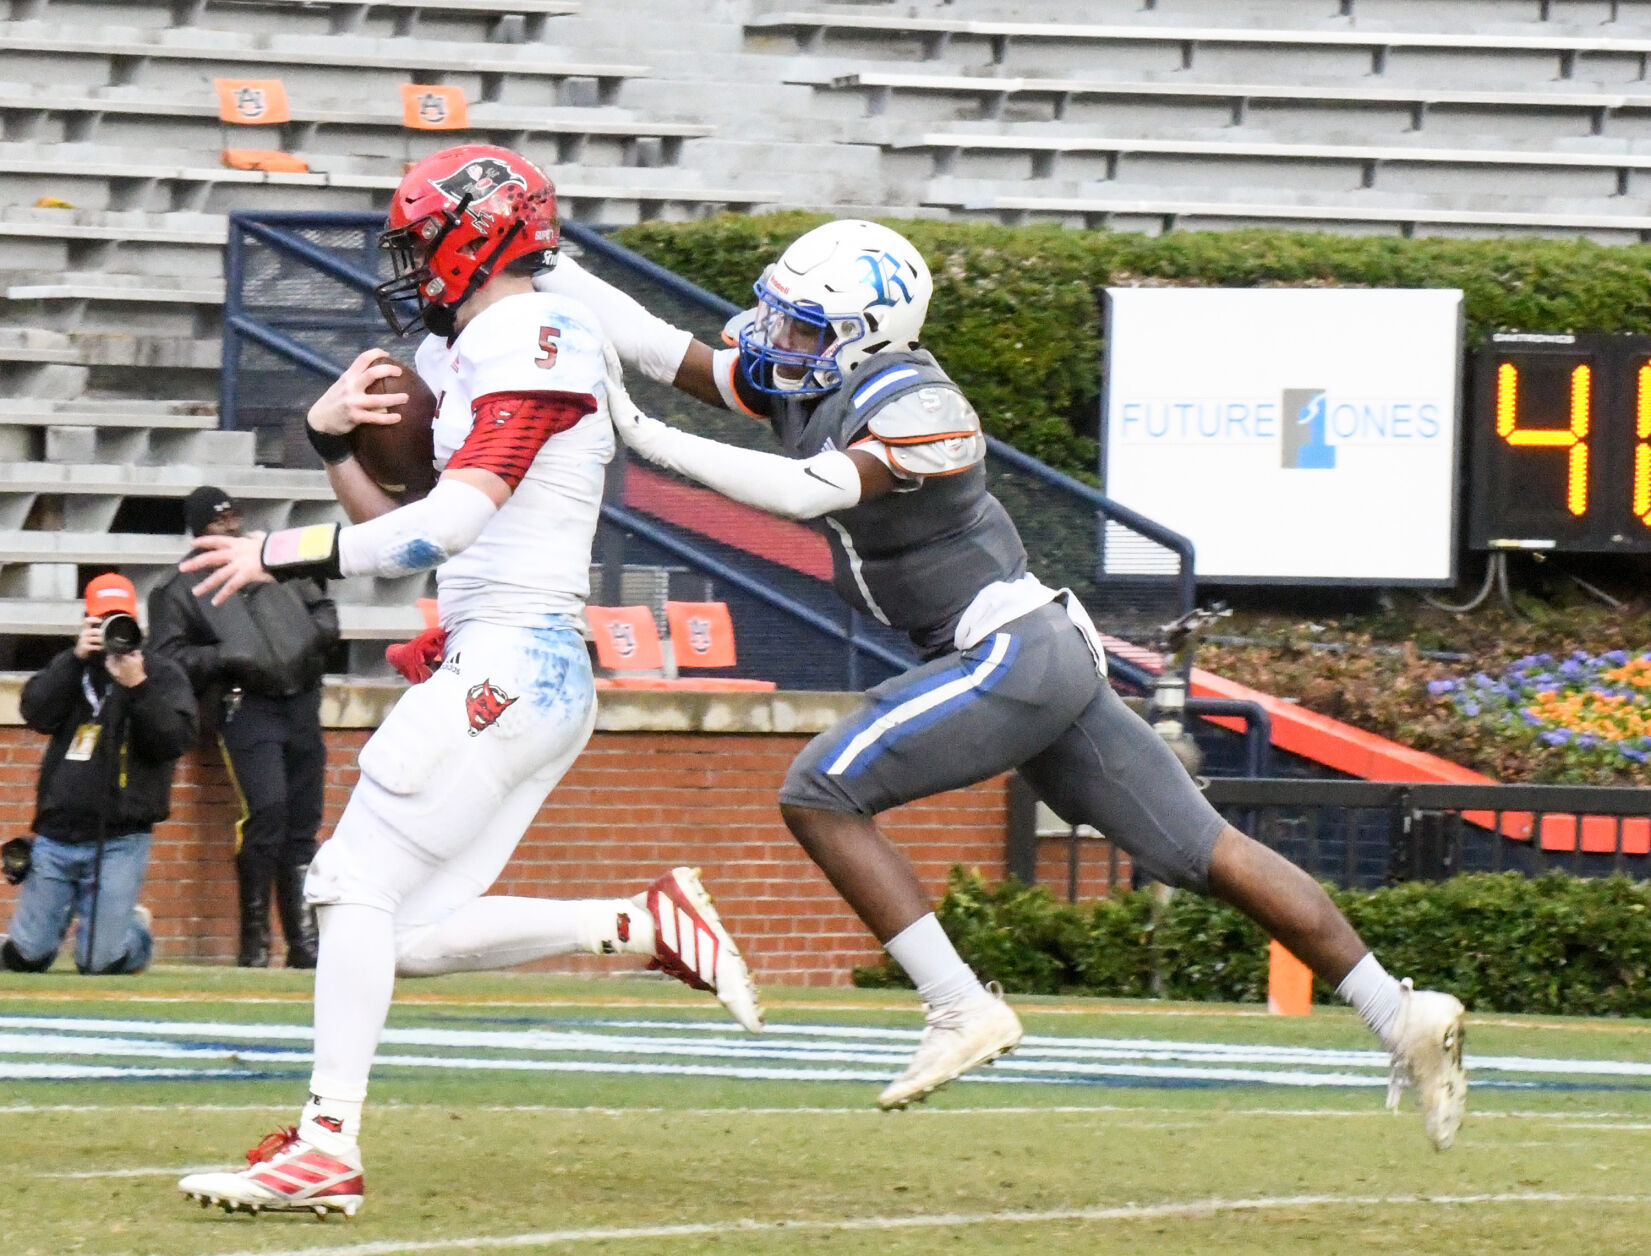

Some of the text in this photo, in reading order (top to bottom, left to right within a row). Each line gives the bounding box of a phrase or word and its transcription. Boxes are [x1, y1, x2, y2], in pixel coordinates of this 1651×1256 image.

[534, 325, 561, 370] 5
[1121, 403, 1276, 438] FUTURE
[1496, 358, 1651, 526] 4
